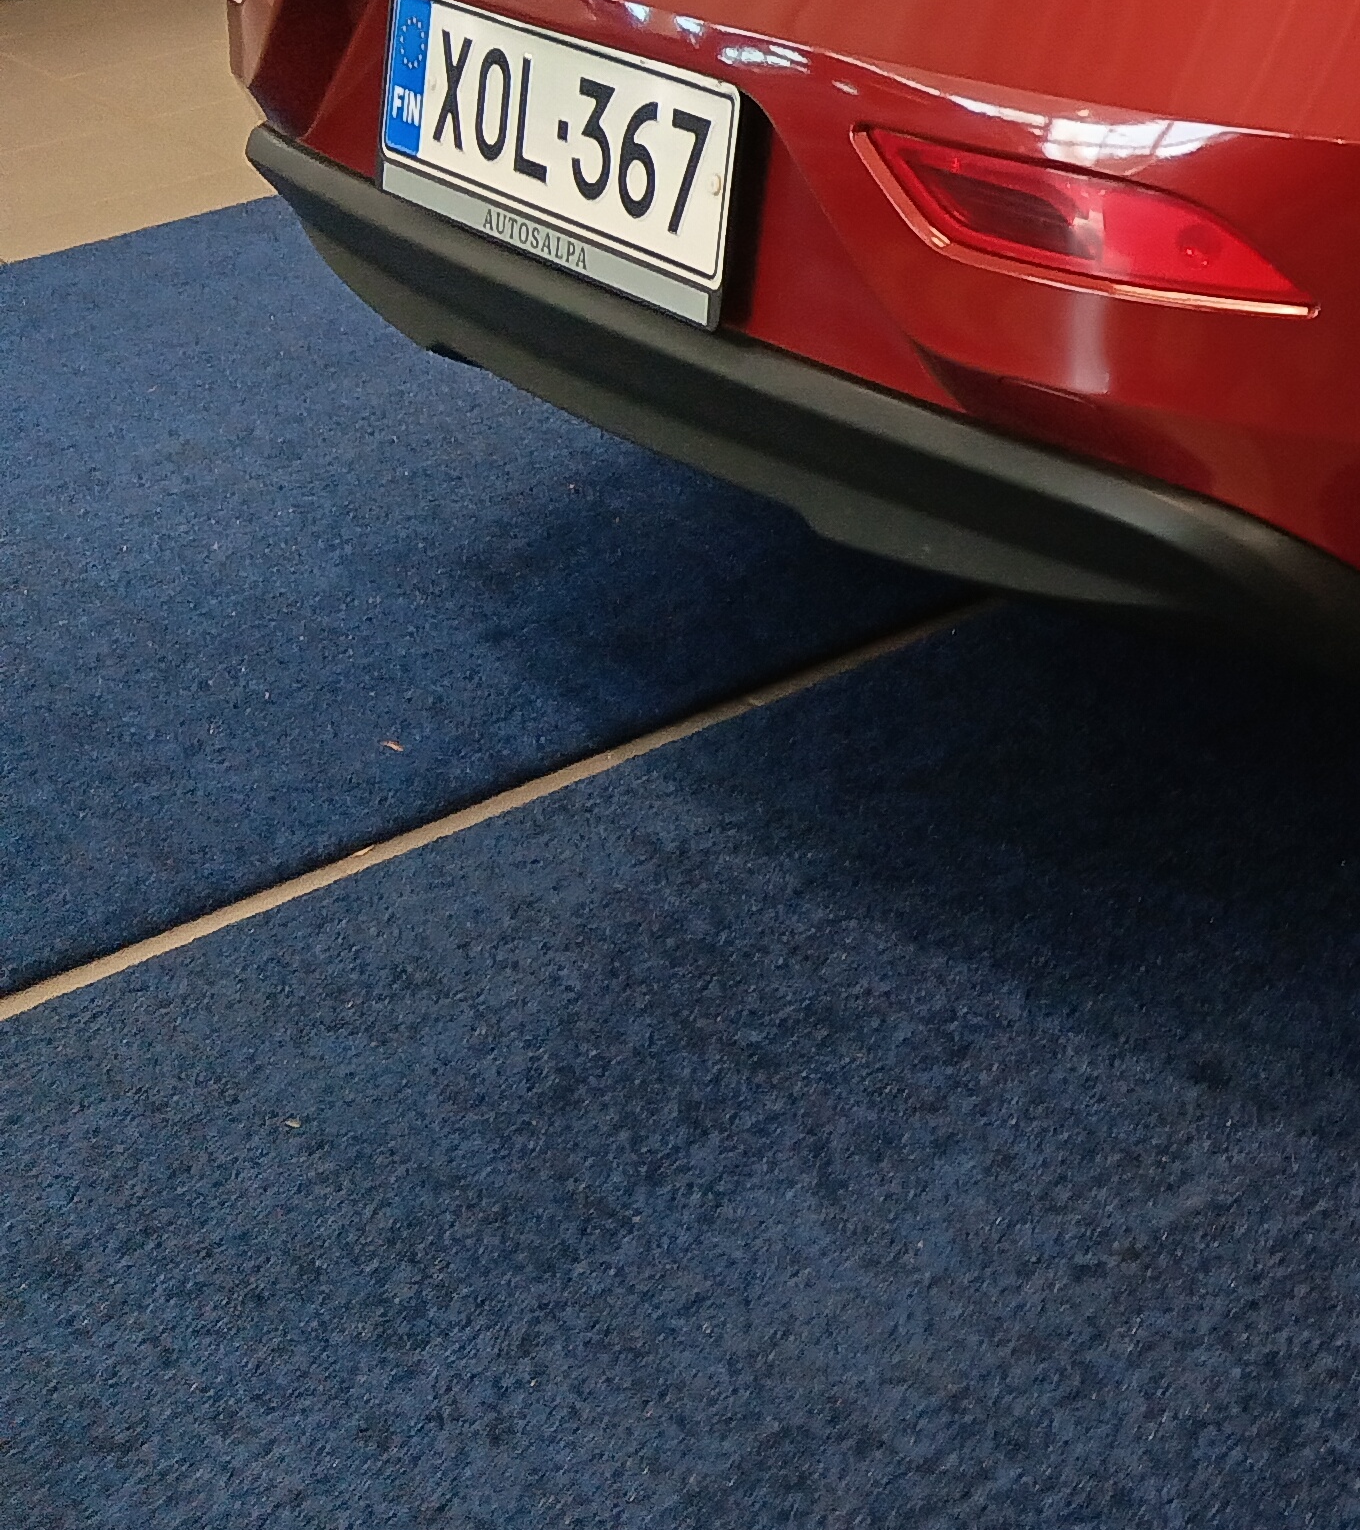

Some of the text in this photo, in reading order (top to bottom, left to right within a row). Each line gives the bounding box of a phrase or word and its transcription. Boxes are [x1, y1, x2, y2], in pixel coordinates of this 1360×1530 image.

[391, 84, 421, 125] FIN
[433, 29, 712, 235] XOL-367
[482, 208, 589, 270] AUTOSALPA
